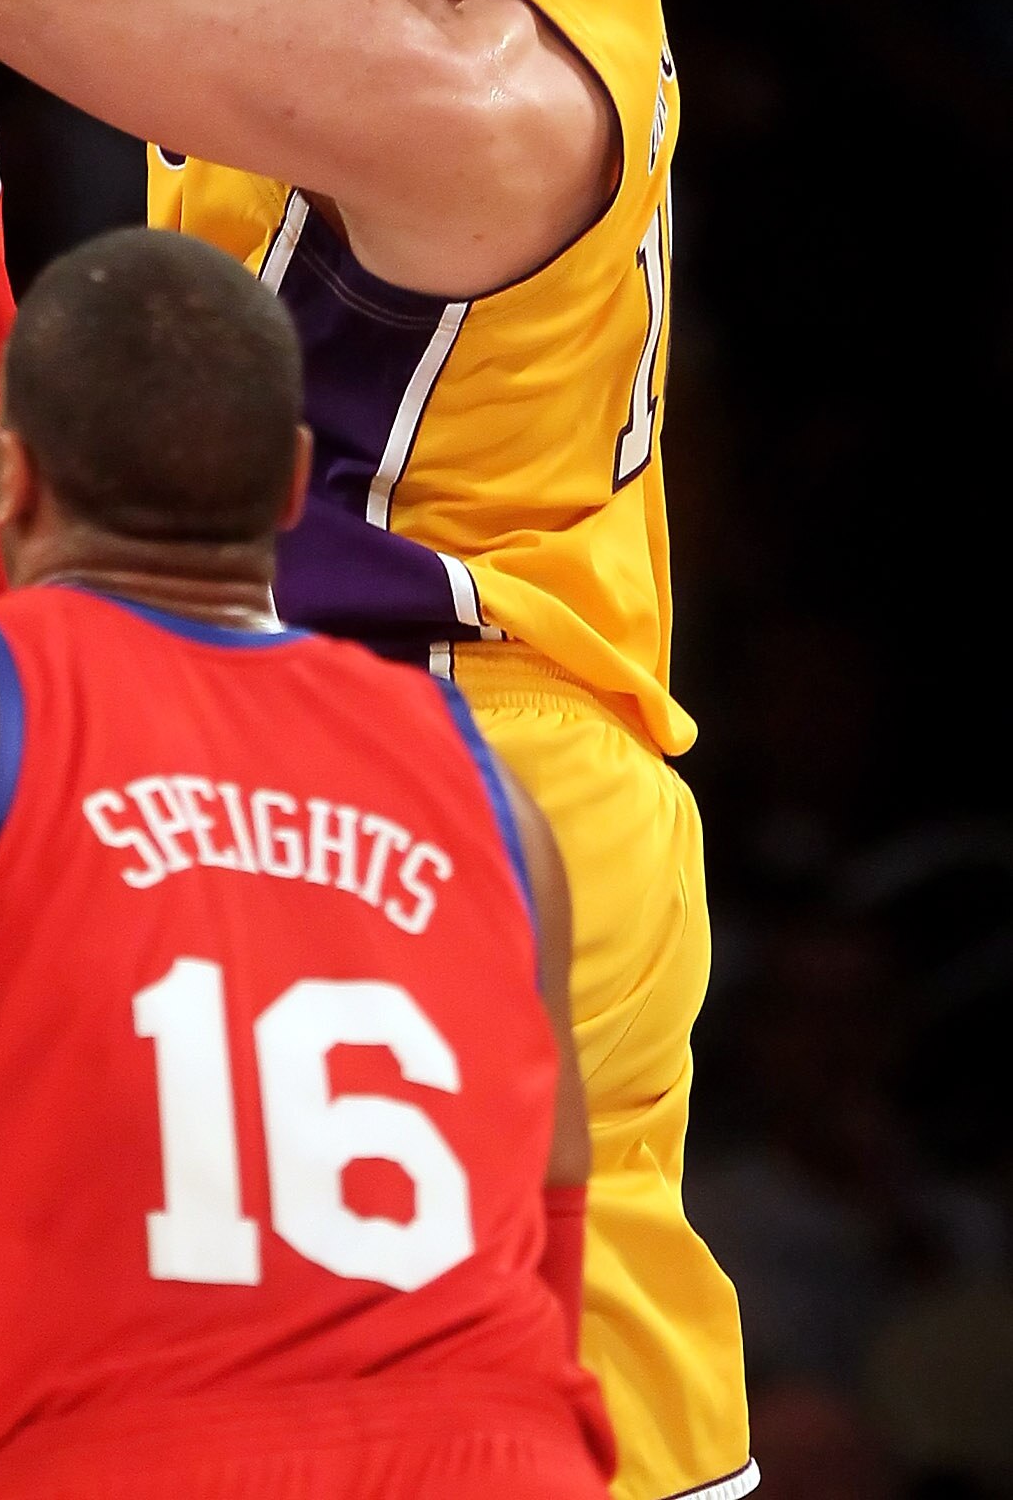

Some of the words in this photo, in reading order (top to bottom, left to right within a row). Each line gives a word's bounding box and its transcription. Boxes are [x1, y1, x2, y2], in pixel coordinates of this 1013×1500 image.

[612, 168, 673, 494] 1
[82, 774, 453, 935] SPEIGHTS
[133, 956, 476, 1293] 16
